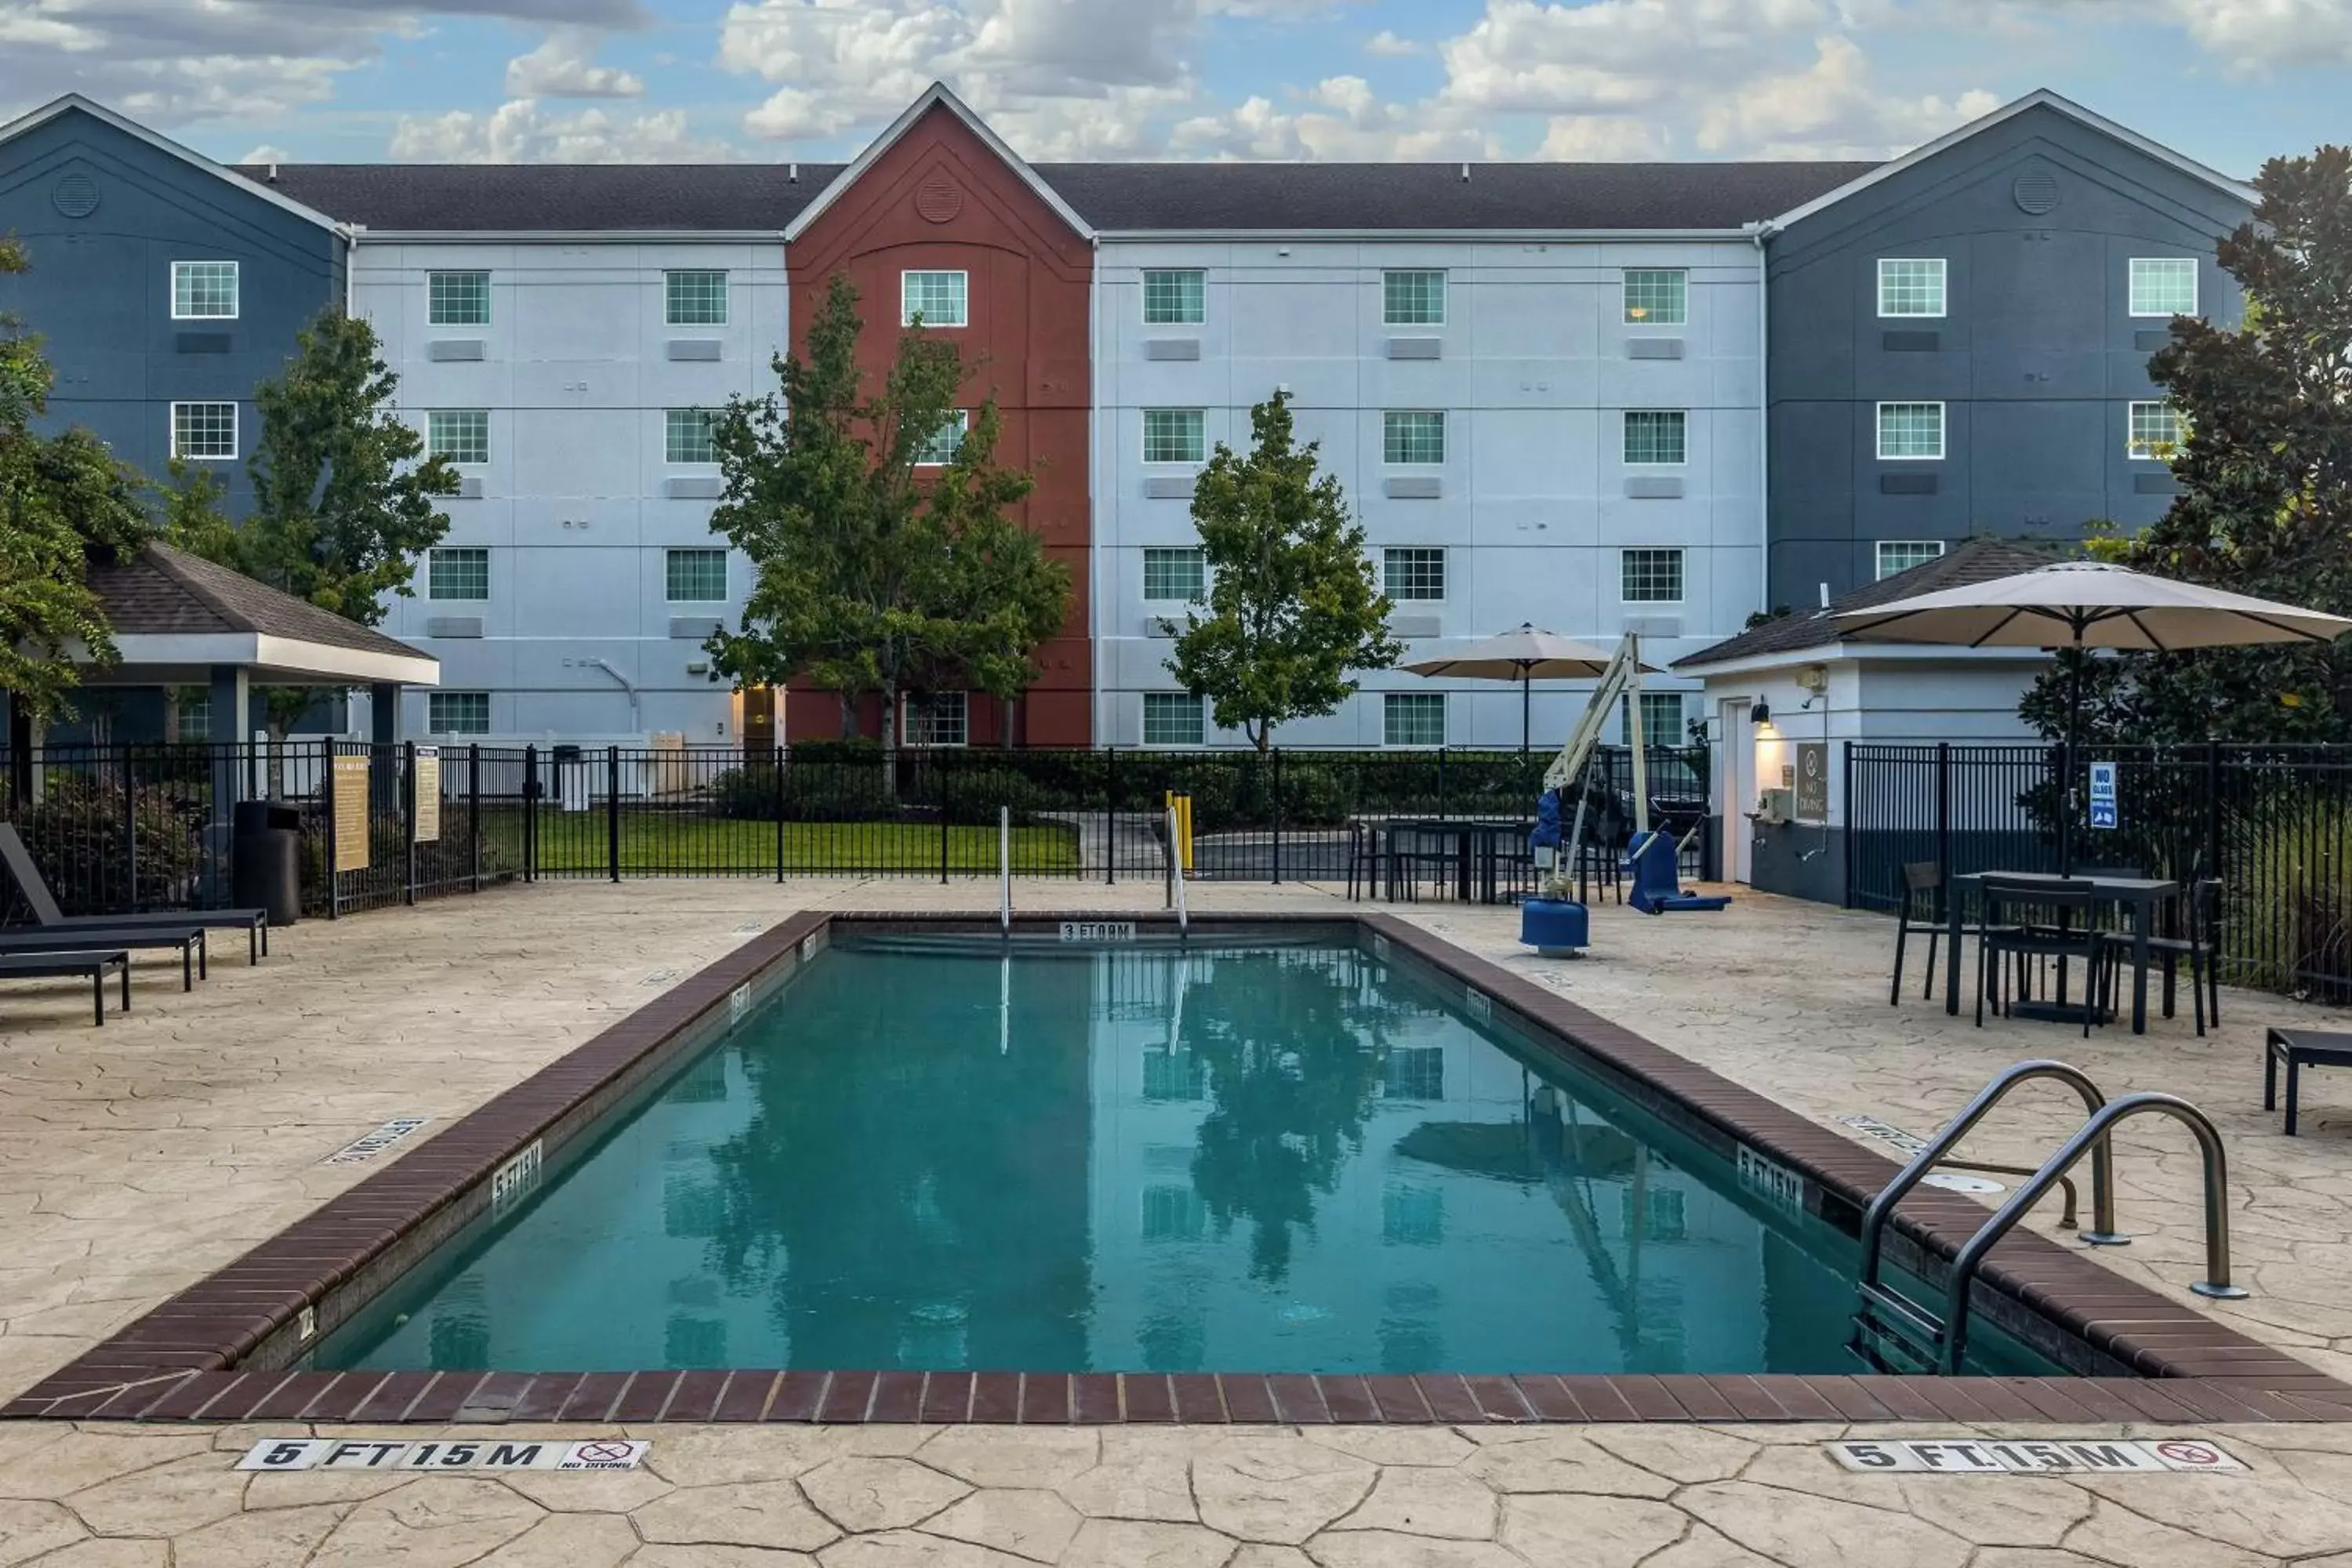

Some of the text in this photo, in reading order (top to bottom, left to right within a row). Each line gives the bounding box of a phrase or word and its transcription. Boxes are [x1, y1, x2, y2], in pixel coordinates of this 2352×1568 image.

[2096, 769, 2110, 782] NO
[263, 1443, 543, 1465] 5 FT 1.5 M
[1844, 1445, 1896, 1467] 5
[2067, 1445, 2139, 1467] M
